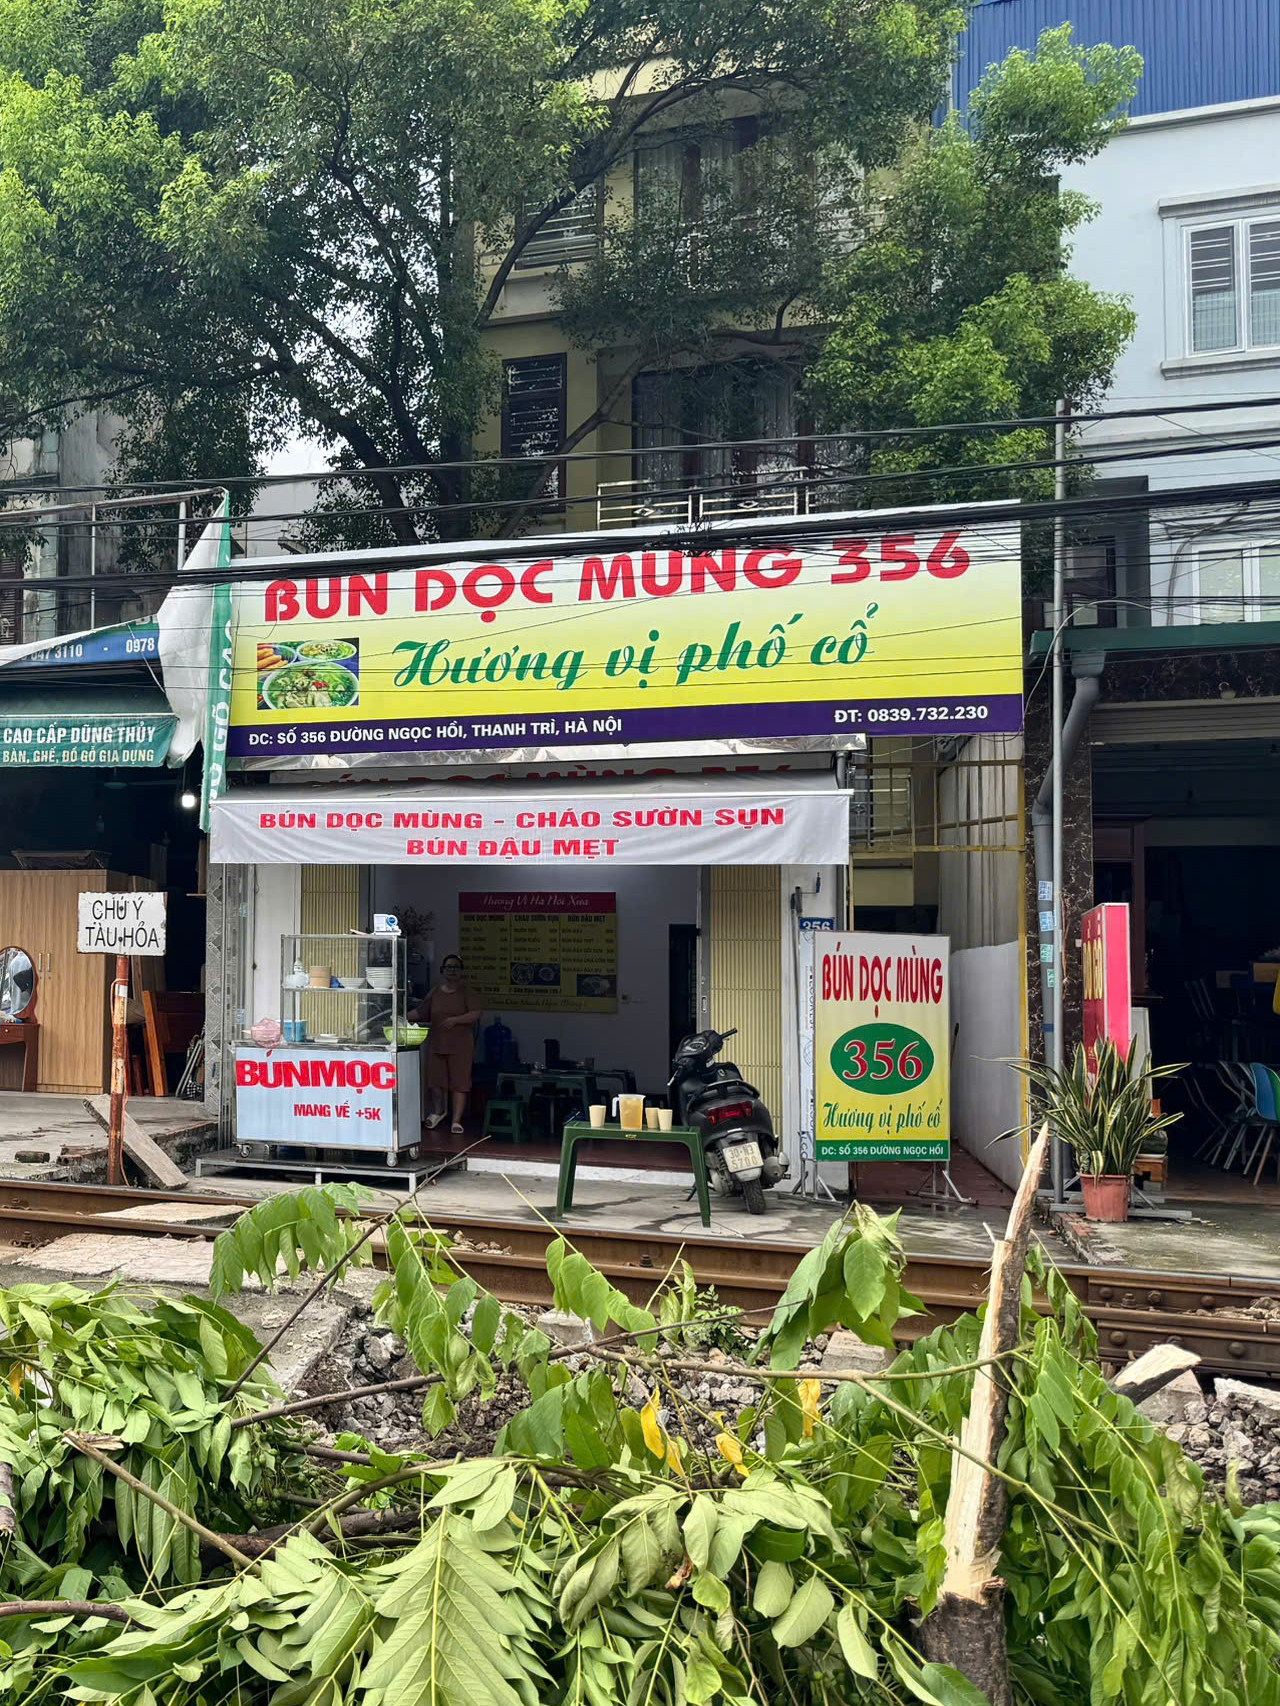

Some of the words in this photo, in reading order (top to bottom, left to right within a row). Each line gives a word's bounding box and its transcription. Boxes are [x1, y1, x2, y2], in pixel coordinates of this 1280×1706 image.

[415, 560, 553, 622] DỌC
[831, 531, 970, 584] 356
[125, 637, 155, 653] 0978
[392, 639, 588, 692] Hương
[604, 630, 659, 688] vị
[675, 612, 804, 686] phố
[809, 602, 880, 665] cổ
[833, 708, 862, 723] ĐT:
[867, 706, 988, 723] 0839.732.230
[4, 728, 32, 744] CAO
[37, 722, 67, 744] CẤP
[71, 725, 113, 743] DŨNG
[117, 721, 156, 743] THỦY
[249, 732, 273, 745] ĐC:
[277, 726, 297, 744] SỐ
[300, 731, 326, 743] 356
[330, 728, 383, 742] ĐƯỜNG
[388, 726, 432, 743] NGỌC
[436, 720, 467, 739] HỒI,
[472, 723, 526, 737] THANH
[531, 718, 560, 736] TRÌ,
[565, 717, 588, 733] HÀ
[593, 716, 622, 735] NỘI
[2, 748, 30, 763] BÀN,
[33, 746, 59, 763] GHẾ,
[99, 750, 119, 762] GIA
[122, 750, 155, 765] DỤNG
[260, 809, 316, 829] BÚN
[326, 812, 383, 832] DỌC
[393, 808, 483, 829] MÙNG
[516, 807, 602, 829] CHÁO
[612, 805, 703, 828] SƯỜN
[714, 807, 785, 830] SỤN
[406, 836, 469, 856] BÚN
[477, 837, 541, 859] ĐẬU
[553, 838, 620, 858] MẸT
[92, 896, 127, 920] CHÚ
[133, 896, 144, 920] Ý
[85, 922, 118, 947] TÀU
[123, 921, 160, 948] HỎA
[803, 921, 830, 930] 356
[822, 941, 854, 1001] BÚN
[859, 955, 891, 1018] DỌC
[896, 945, 943, 1004] MÙNG
[842, 1038, 924, 1080] 356
[293, 1104, 331, 1117] MANG
[355, 1107, 382, 1121] +5K
[823, 1102, 874, 1133] Hương
[879, 1104, 893, 1135] vị
[896, 1100, 926, 1133] phố
[838, 1143, 851, 1155] SỐ
[852, 1147, 868, 1155] 356
[870, 1145, 901, 1155] ĐƯỜNG
[903, 1147, 927, 1157] NGỌC
